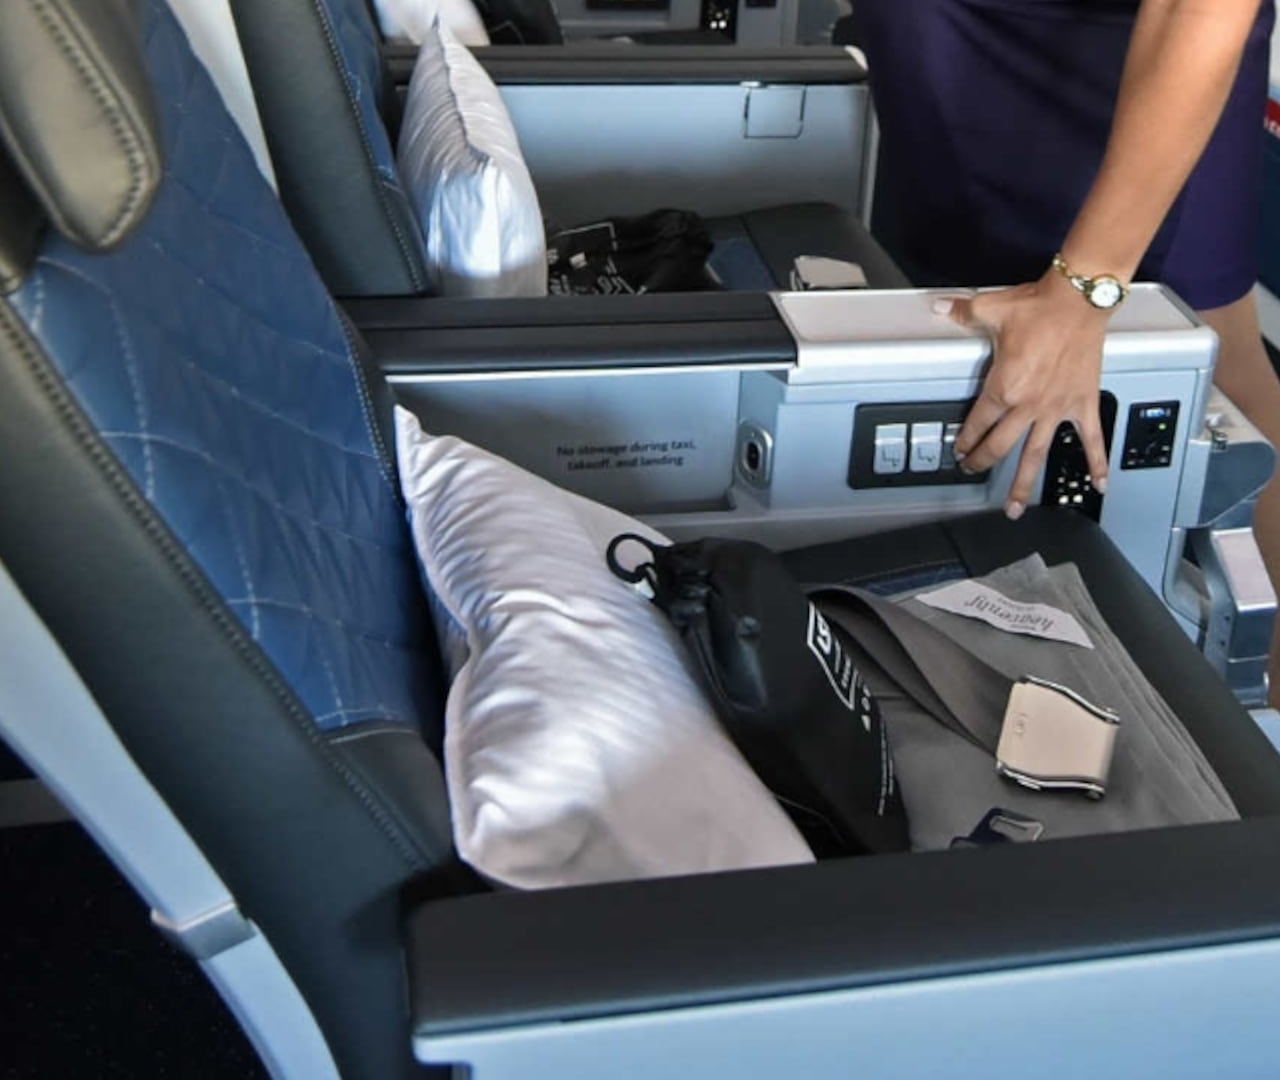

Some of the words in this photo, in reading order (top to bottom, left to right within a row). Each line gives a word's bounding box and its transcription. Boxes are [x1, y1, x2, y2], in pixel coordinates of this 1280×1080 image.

[630, 441, 668, 453] during
[614, 457, 638, 469] and
[639, 455, 684, 467] landing
